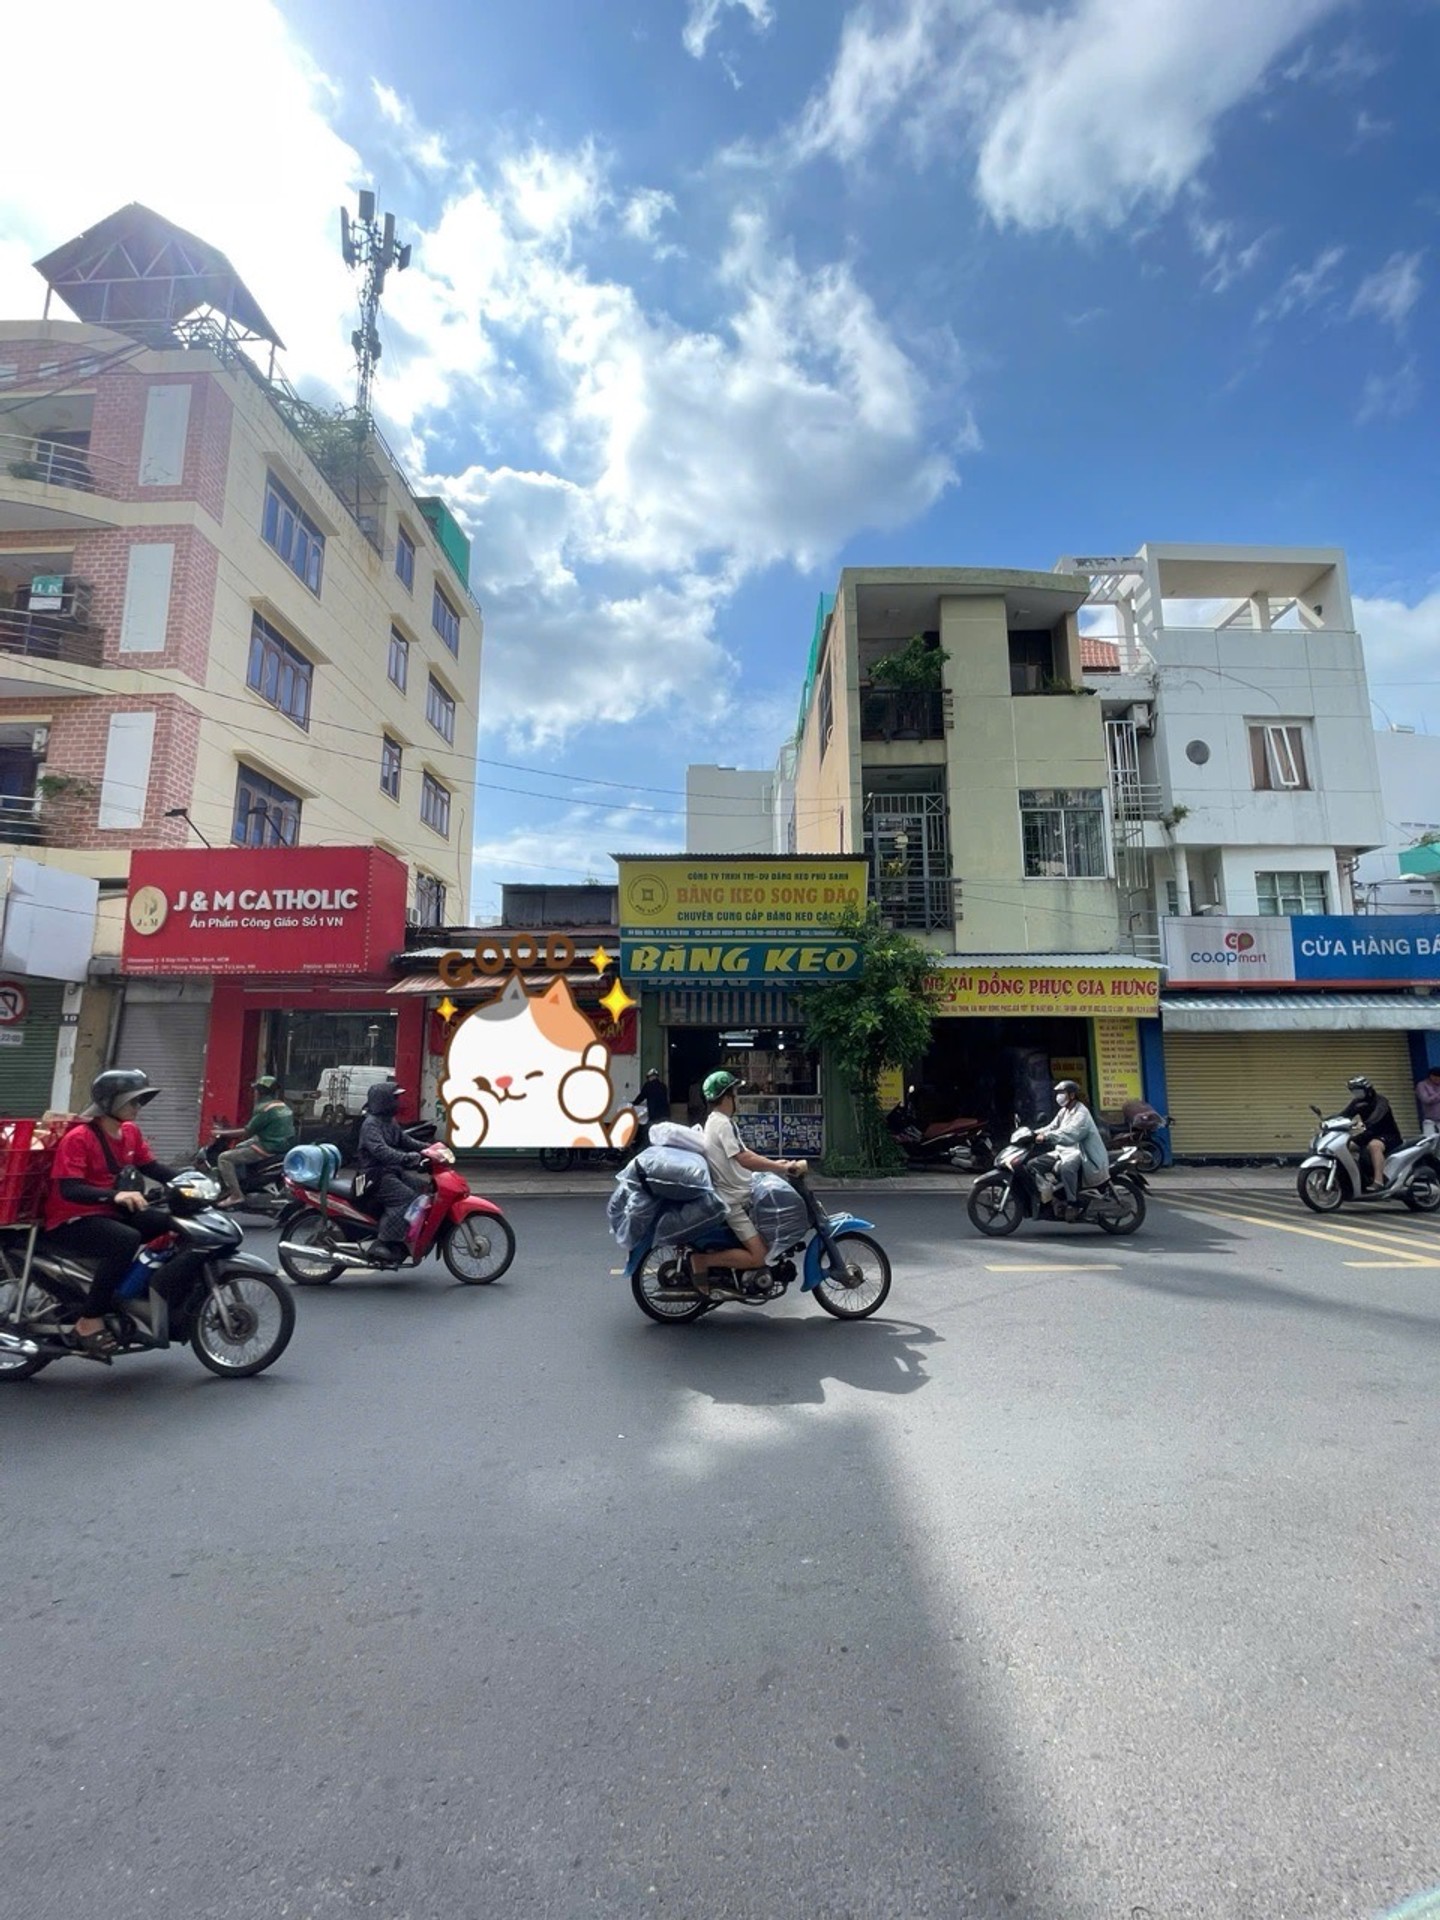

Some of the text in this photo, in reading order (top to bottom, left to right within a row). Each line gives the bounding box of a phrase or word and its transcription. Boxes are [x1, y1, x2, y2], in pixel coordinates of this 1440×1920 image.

[190, 890, 208, 912] &
[213, 890, 235, 911] M
[238, 888, 359, 911] CATHOLIC
[677, 884, 724, 903] BĂNG
[730, 888, 766, 903] KEO
[771, 888, 817, 903] SONG
[241, 917, 271, 930] Công
[273, 917, 299, 928] Giáo
[326, 917, 344, 927] VN
[677, 911, 714, 921] CHUYÊN
[716, 912, 742, 921] CUNG
[766, 909, 792, 921] BĂNG
[795, 911, 813, 921] KEO
[1301, 934, 1440, 956] CỬA HÀNG BÁ
[630, 945, 858, 972] BĂNG KEO
[1029, 979, 1072, 999] PHỤC
[1077, 979, 1106, 996] GIA
[1111, 978, 1158, 996] HƯNG
